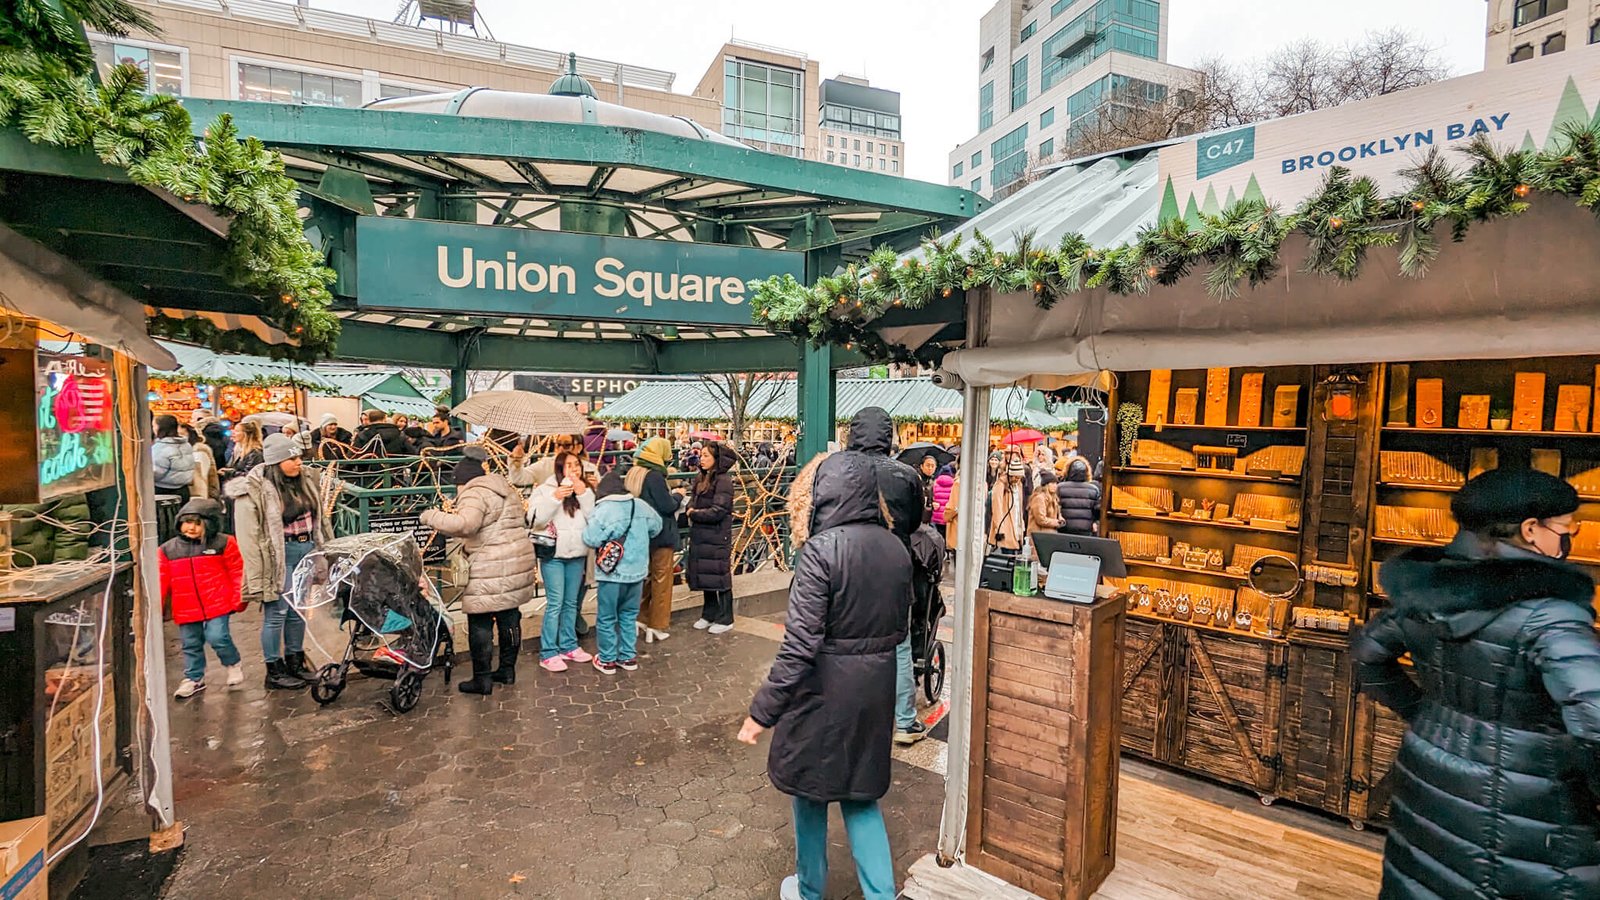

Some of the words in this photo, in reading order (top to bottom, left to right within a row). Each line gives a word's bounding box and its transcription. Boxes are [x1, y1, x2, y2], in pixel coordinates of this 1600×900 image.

[1206, 139, 1244, 160] C47
[1281, 129, 1433, 174] BROOKLYN
[1446, 112, 1511, 141] BAY
[437, 246, 576, 295] Union
[593, 257, 746, 307] Square
[571, 379, 659, 393] SEPHO
